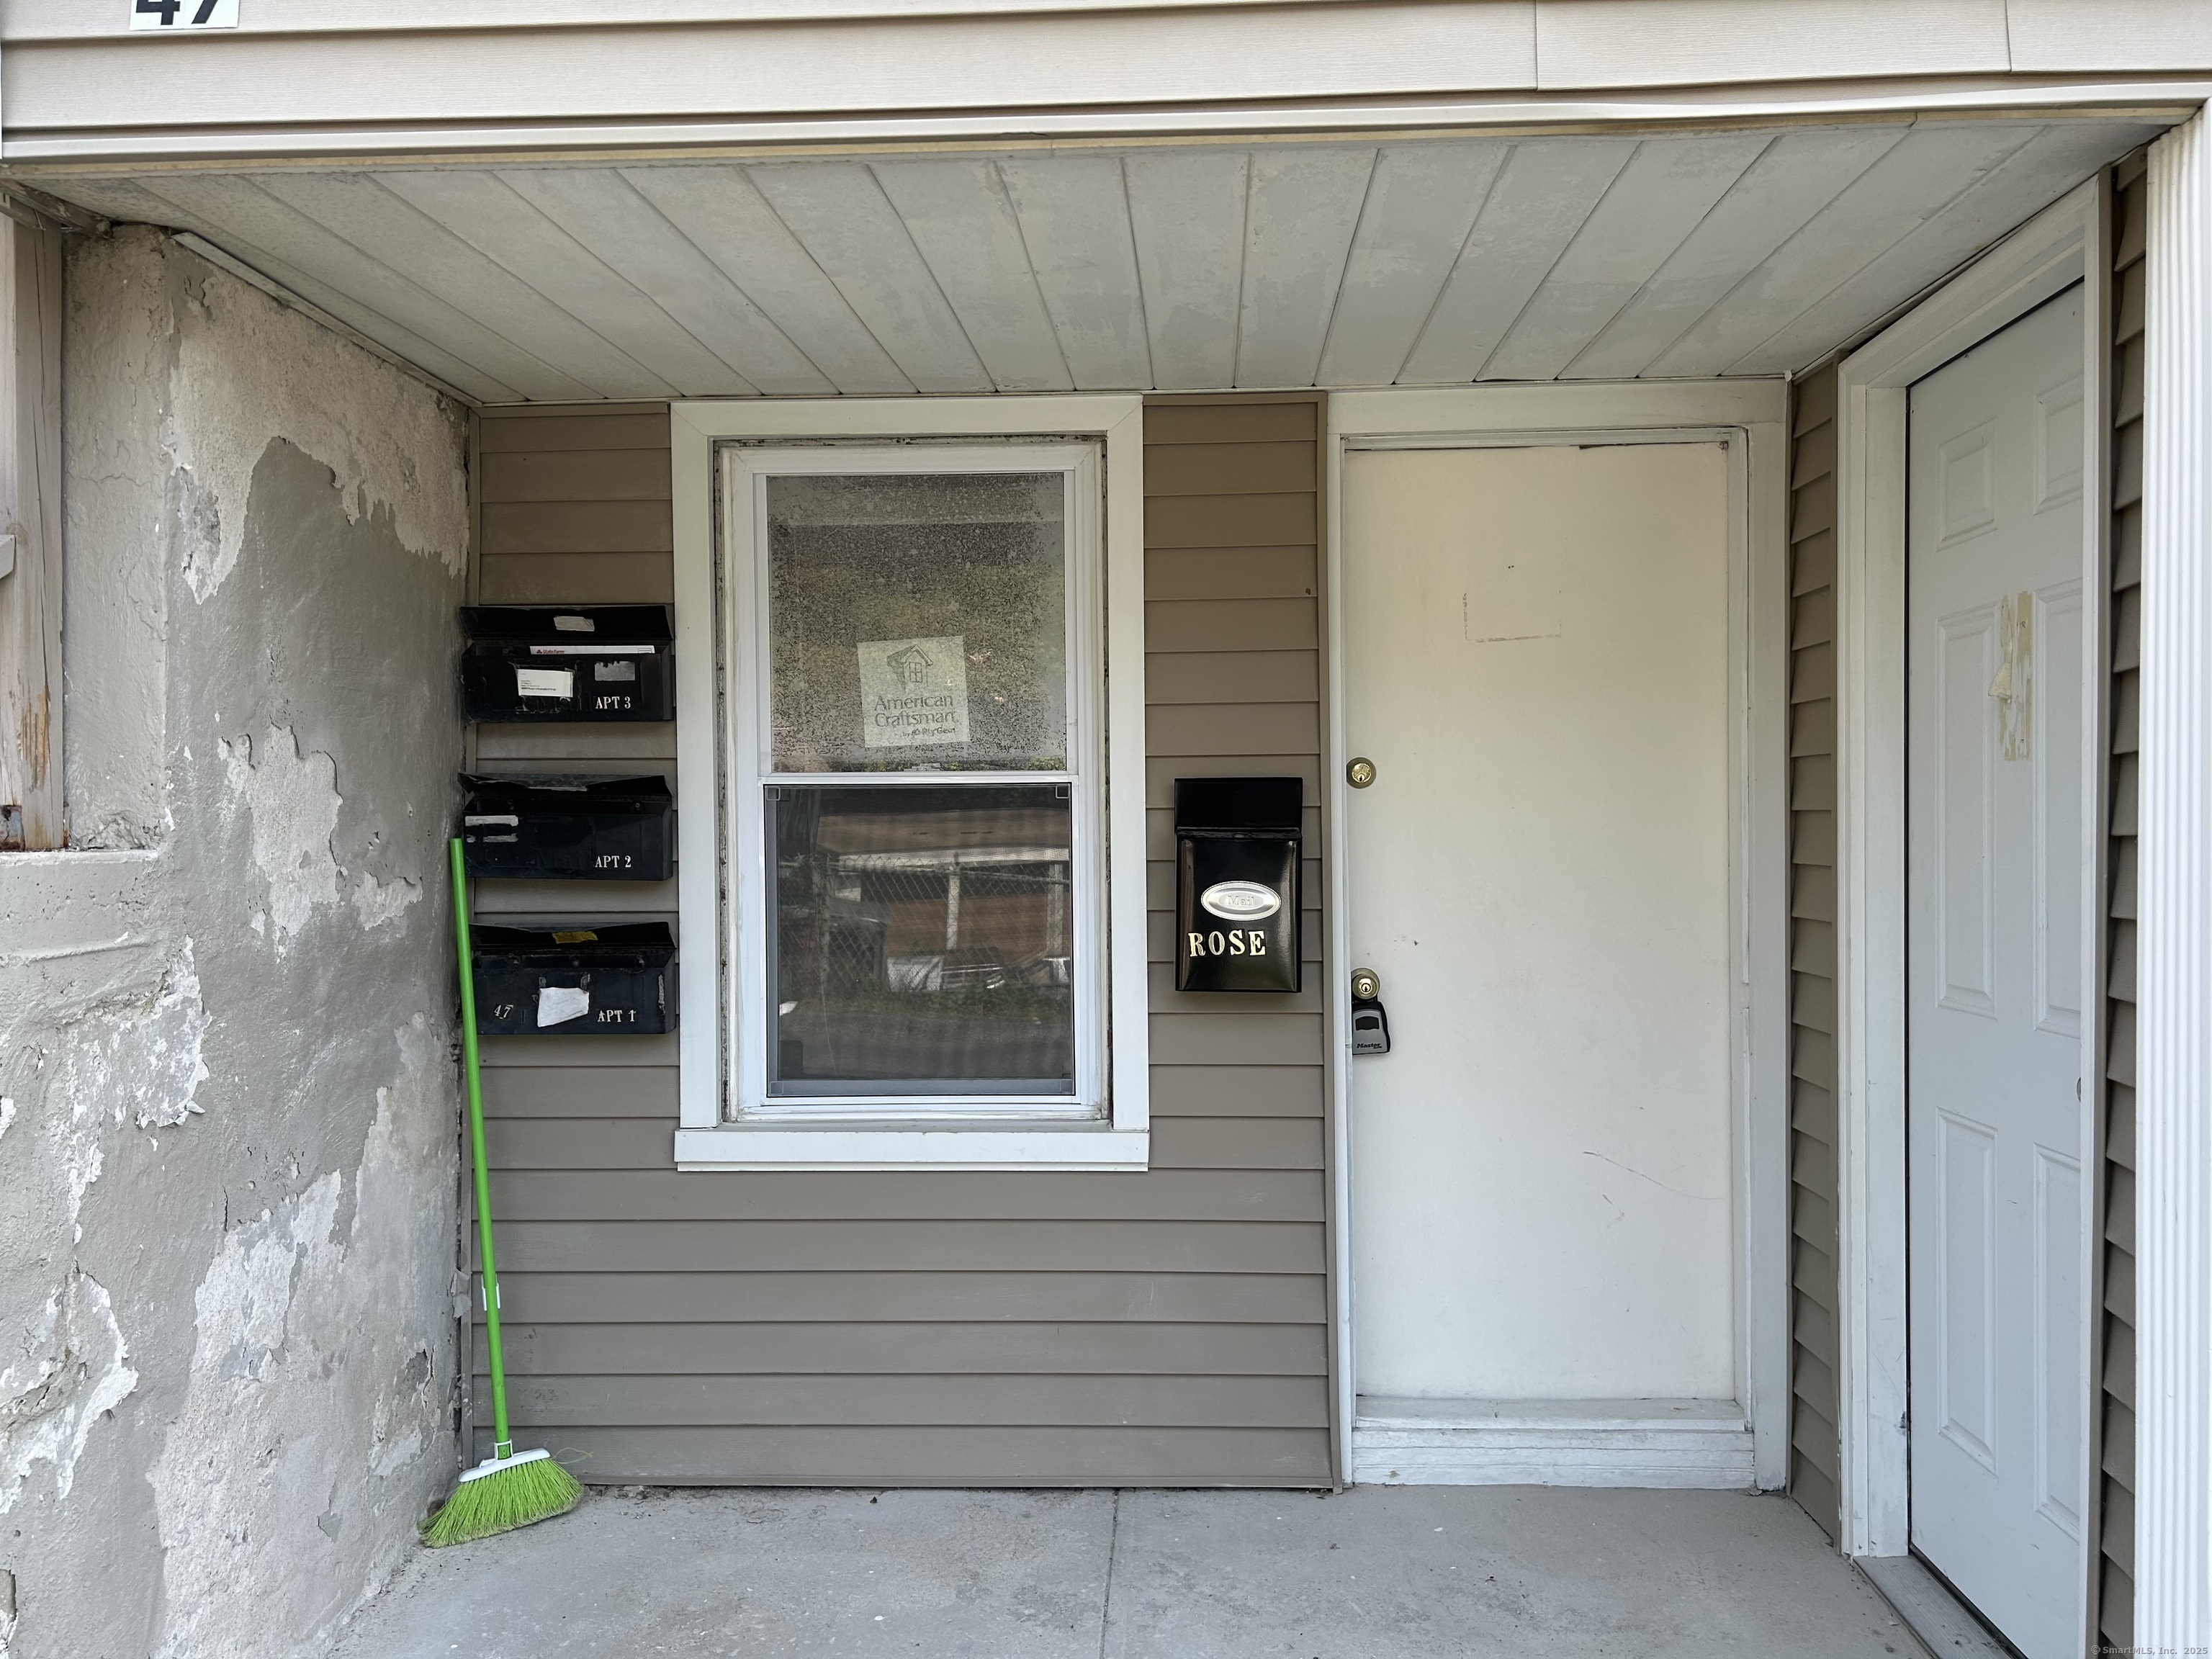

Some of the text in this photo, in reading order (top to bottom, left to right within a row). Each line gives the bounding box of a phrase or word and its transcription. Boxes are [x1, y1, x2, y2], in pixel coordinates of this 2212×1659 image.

[595, 696, 620, 709] APT
[624, 697, 631, 709] 3
[874, 695, 954, 711] American
[875, 710, 955, 728] Craftsman
[595, 855, 631, 868] APT 2
[1227, 895, 1255, 907] Mail
[1188, 929, 1266, 958] ROSE
[494, 1004, 513, 1020] 47
[597, 1010, 637, 1022] APT 1
